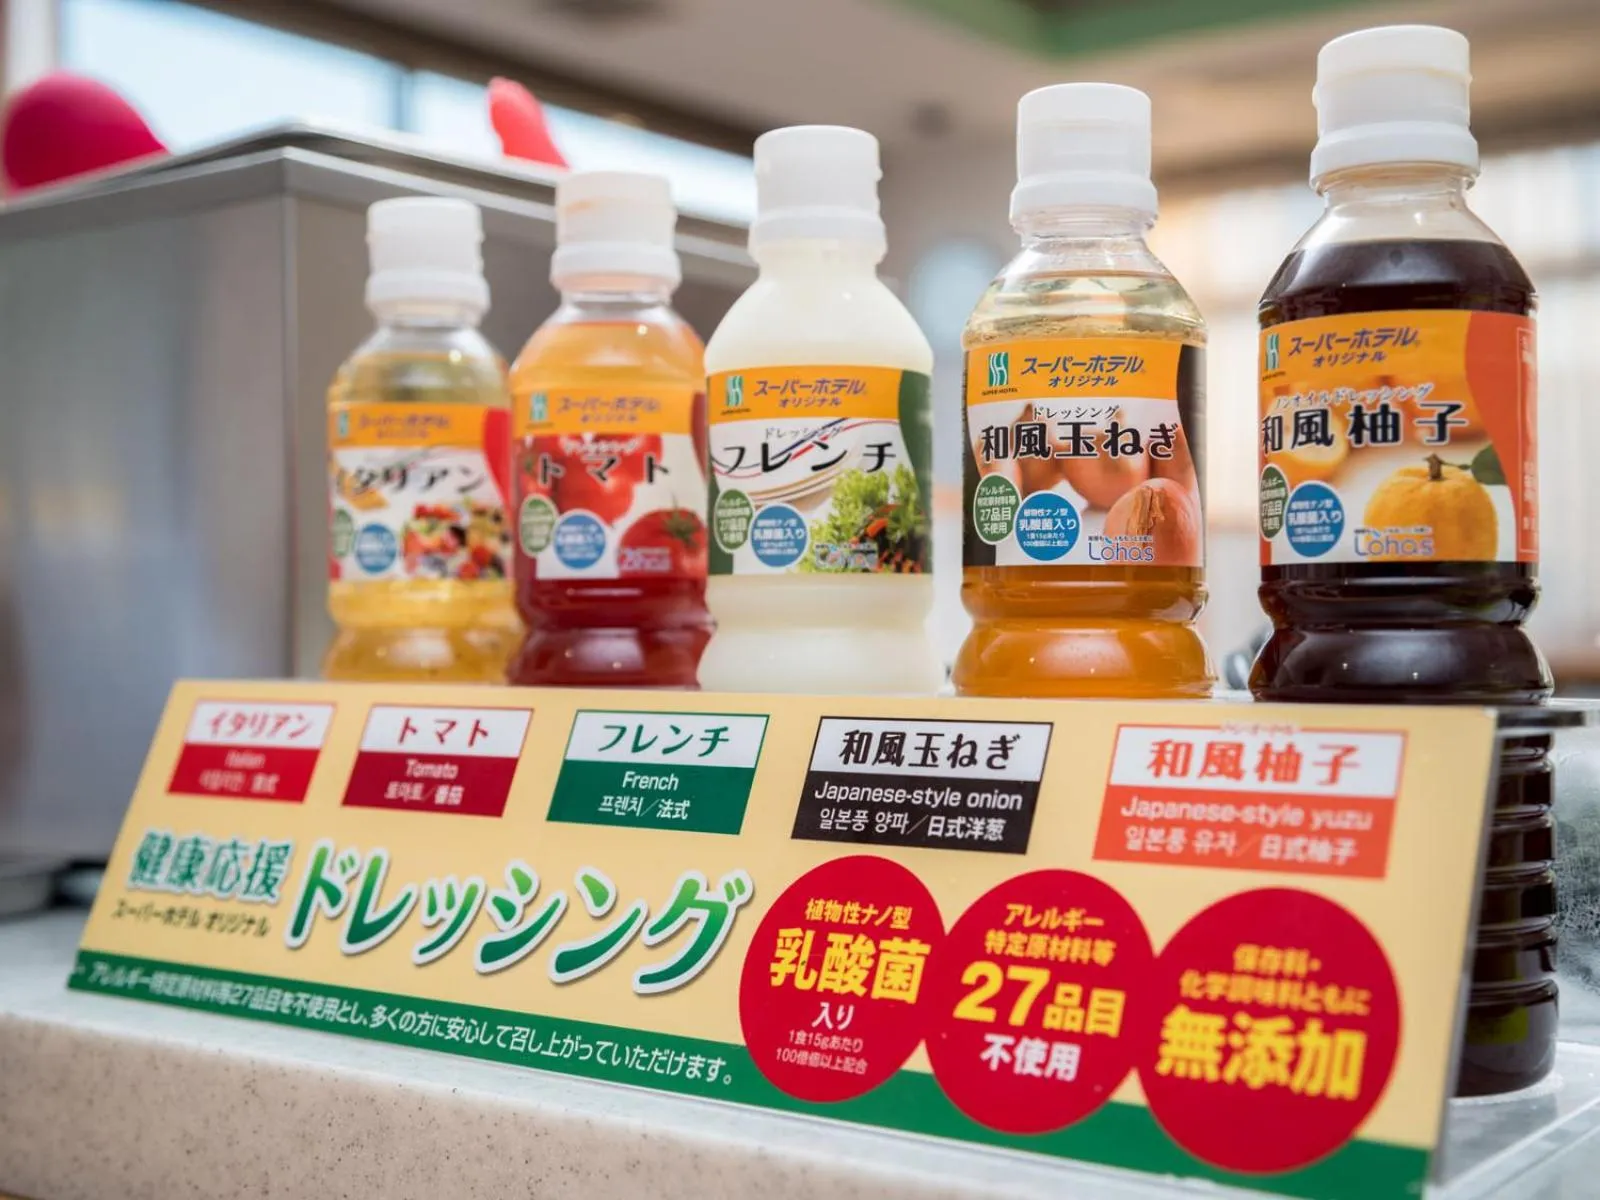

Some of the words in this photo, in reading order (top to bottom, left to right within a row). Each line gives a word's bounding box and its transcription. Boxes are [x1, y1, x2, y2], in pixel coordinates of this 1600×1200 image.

[1289, 327, 1418, 356] スーパーホテル
[1020, 355, 1143, 375] スーパーホテル
[1313, 352, 1385, 366] オリジナル
[1048, 376, 1118, 387] オリジナル
[1032, 404, 1119, 419] ドレッシング
[981, 421, 1179, 461] 和風玉ねぎ
[1262, 403, 1467, 454] 和風柚子
[540, 455, 670, 485] トマト
[723, 442, 896, 473] フレンチ
[980, 507, 1011, 521] 27品目
[1088, 542, 1153, 560] Lohas
[208, 709, 313, 740] イタリアン
[398, 716, 489, 748] トマト
[598, 724, 730, 757] フレンチ
[839, 729, 1021, 770] 和風玉ねぎ
[405, 758, 459, 779] Tomato
[1146, 738, 1361, 786] 和風柚子
[622, 771, 679, 791] French
[814, 781, 962, 808] Japanese-style
[967, 790, 1023, 811] onion
[819, 808, 869, 832] 일본풍
[1121, 795, 1304, 829] Japanese-style
[1310, 808, 1374, 831] yuzu
[130, 832, 290, 898] 健康応援
[287, 842, 750, 989] ドレッシング
[805, 897, 913, 930] 植物性ナノ型
[1004, 903, 1104, 932] アレルギー
[984, 928, 1117, 967] 特定原材料等
[769, 927, 932, 1004] 乳酸菌
[952, 960, 1126, 1038] 27品目
[811, 1001, 855, 1031] 入り
[980, 1032, 1081, 1081] 不使用
[1155, 1004, 1367, 1100] 無添加
